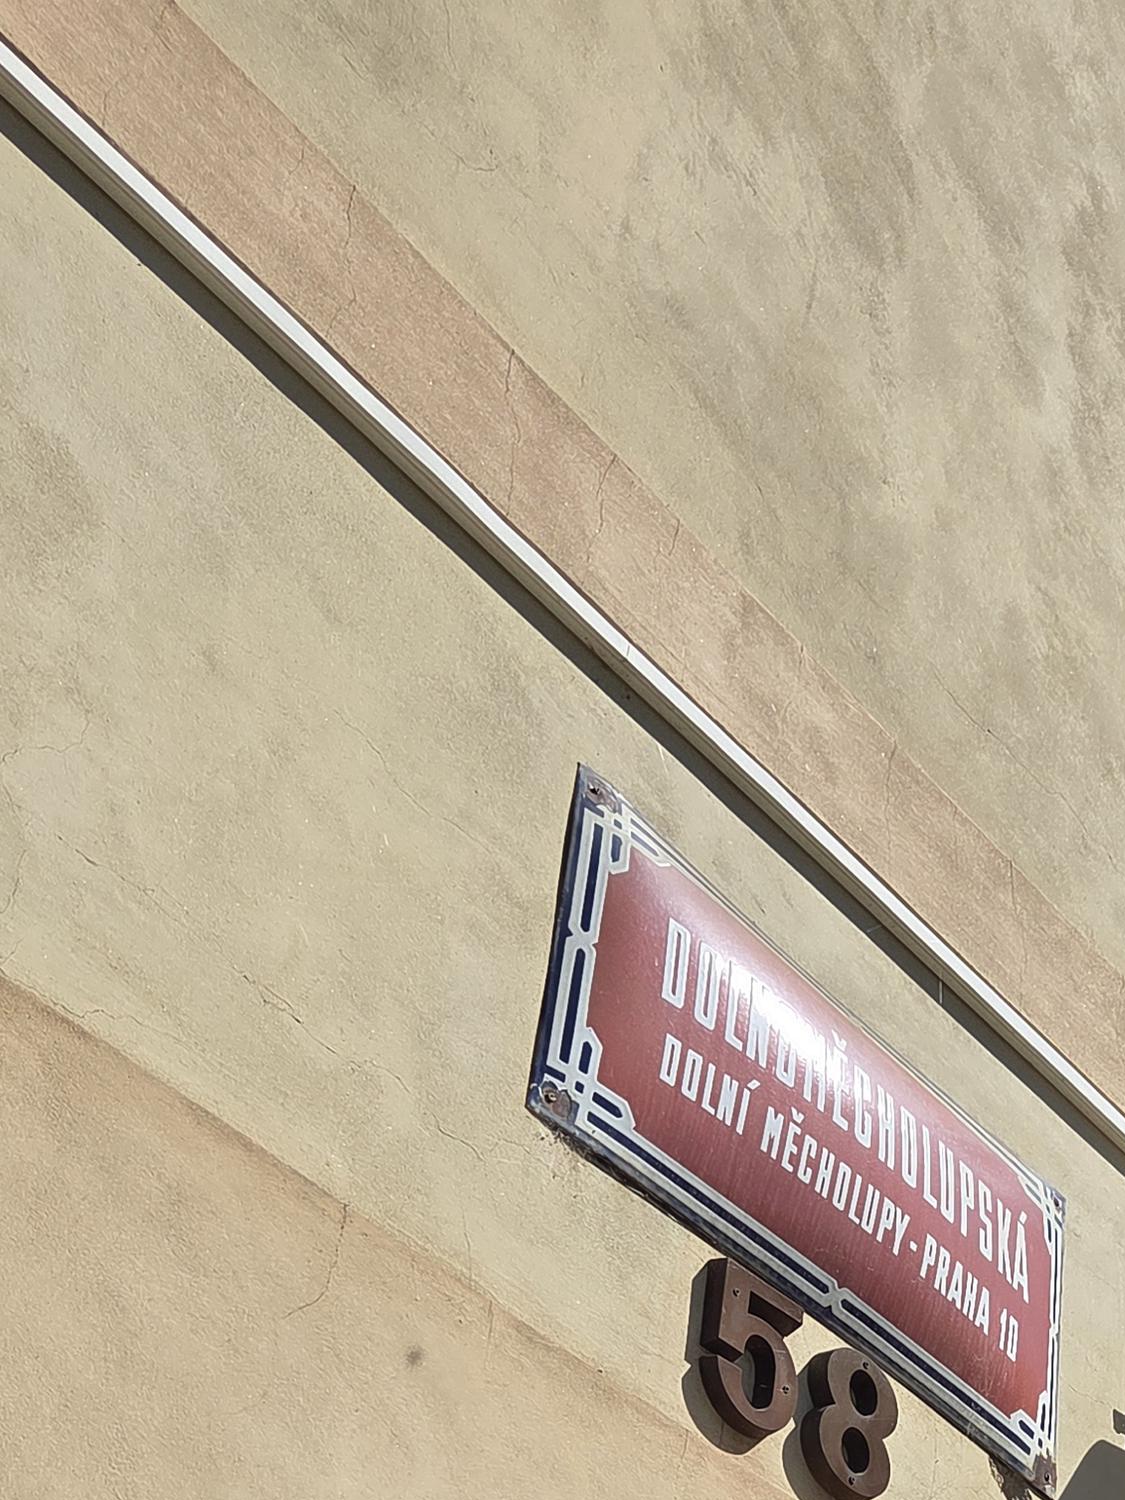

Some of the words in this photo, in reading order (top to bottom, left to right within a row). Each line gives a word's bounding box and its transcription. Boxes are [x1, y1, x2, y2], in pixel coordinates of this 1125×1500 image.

[659, 1033, 760, 1136] DOLNÍ
[760, 1105, 911, 1257] MĚCHOLUPY
[919, 1233, 989, 1336] PRAHA
[999, 1307, 1019, 1362] 10
